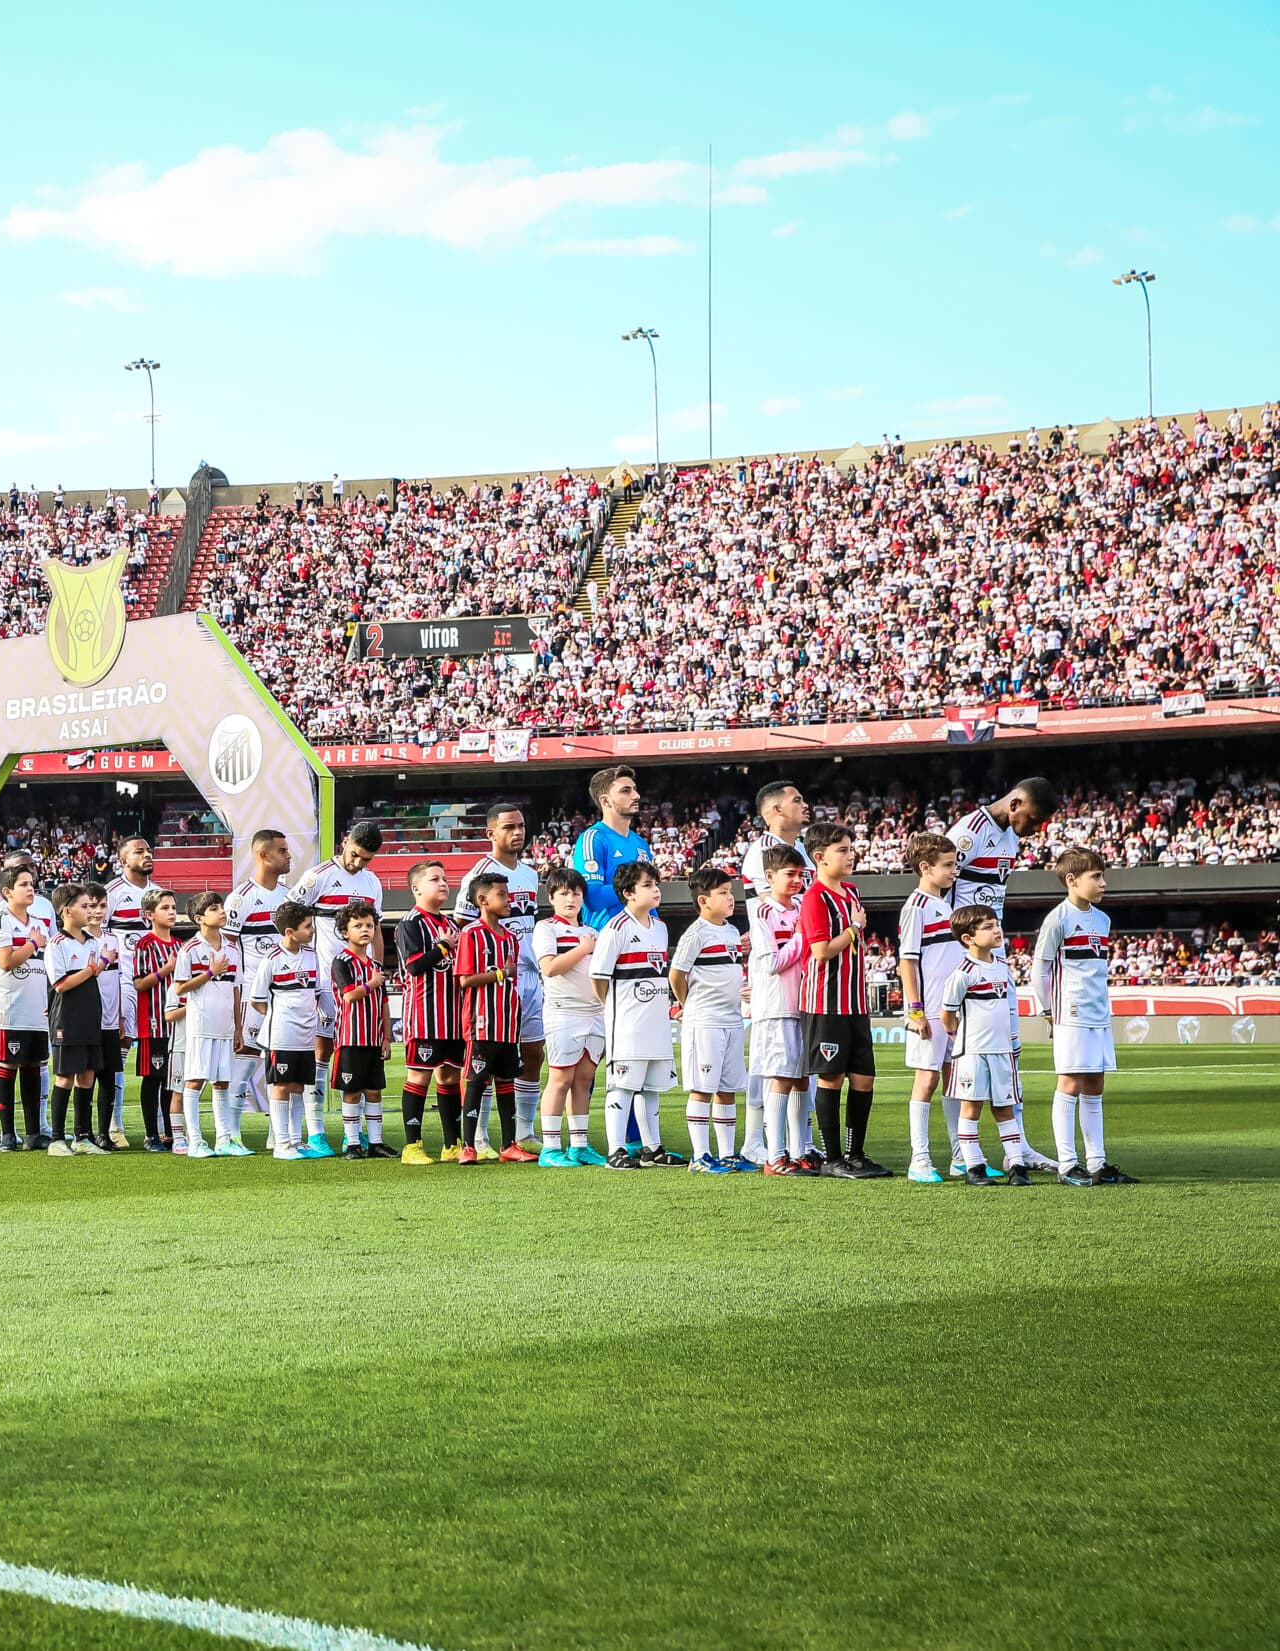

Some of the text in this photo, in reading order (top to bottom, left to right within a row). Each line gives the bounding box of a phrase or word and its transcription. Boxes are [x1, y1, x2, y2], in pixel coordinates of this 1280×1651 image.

[367, 624, 459, 657] 2 VÍTOR
[6, 679, 167, 719] BRASILEIRÃO
[58, 716, 109, 740] ASSAÍ
[658, 737, 697, 751] CLUBE
[698, 736, 716, 749] DA
